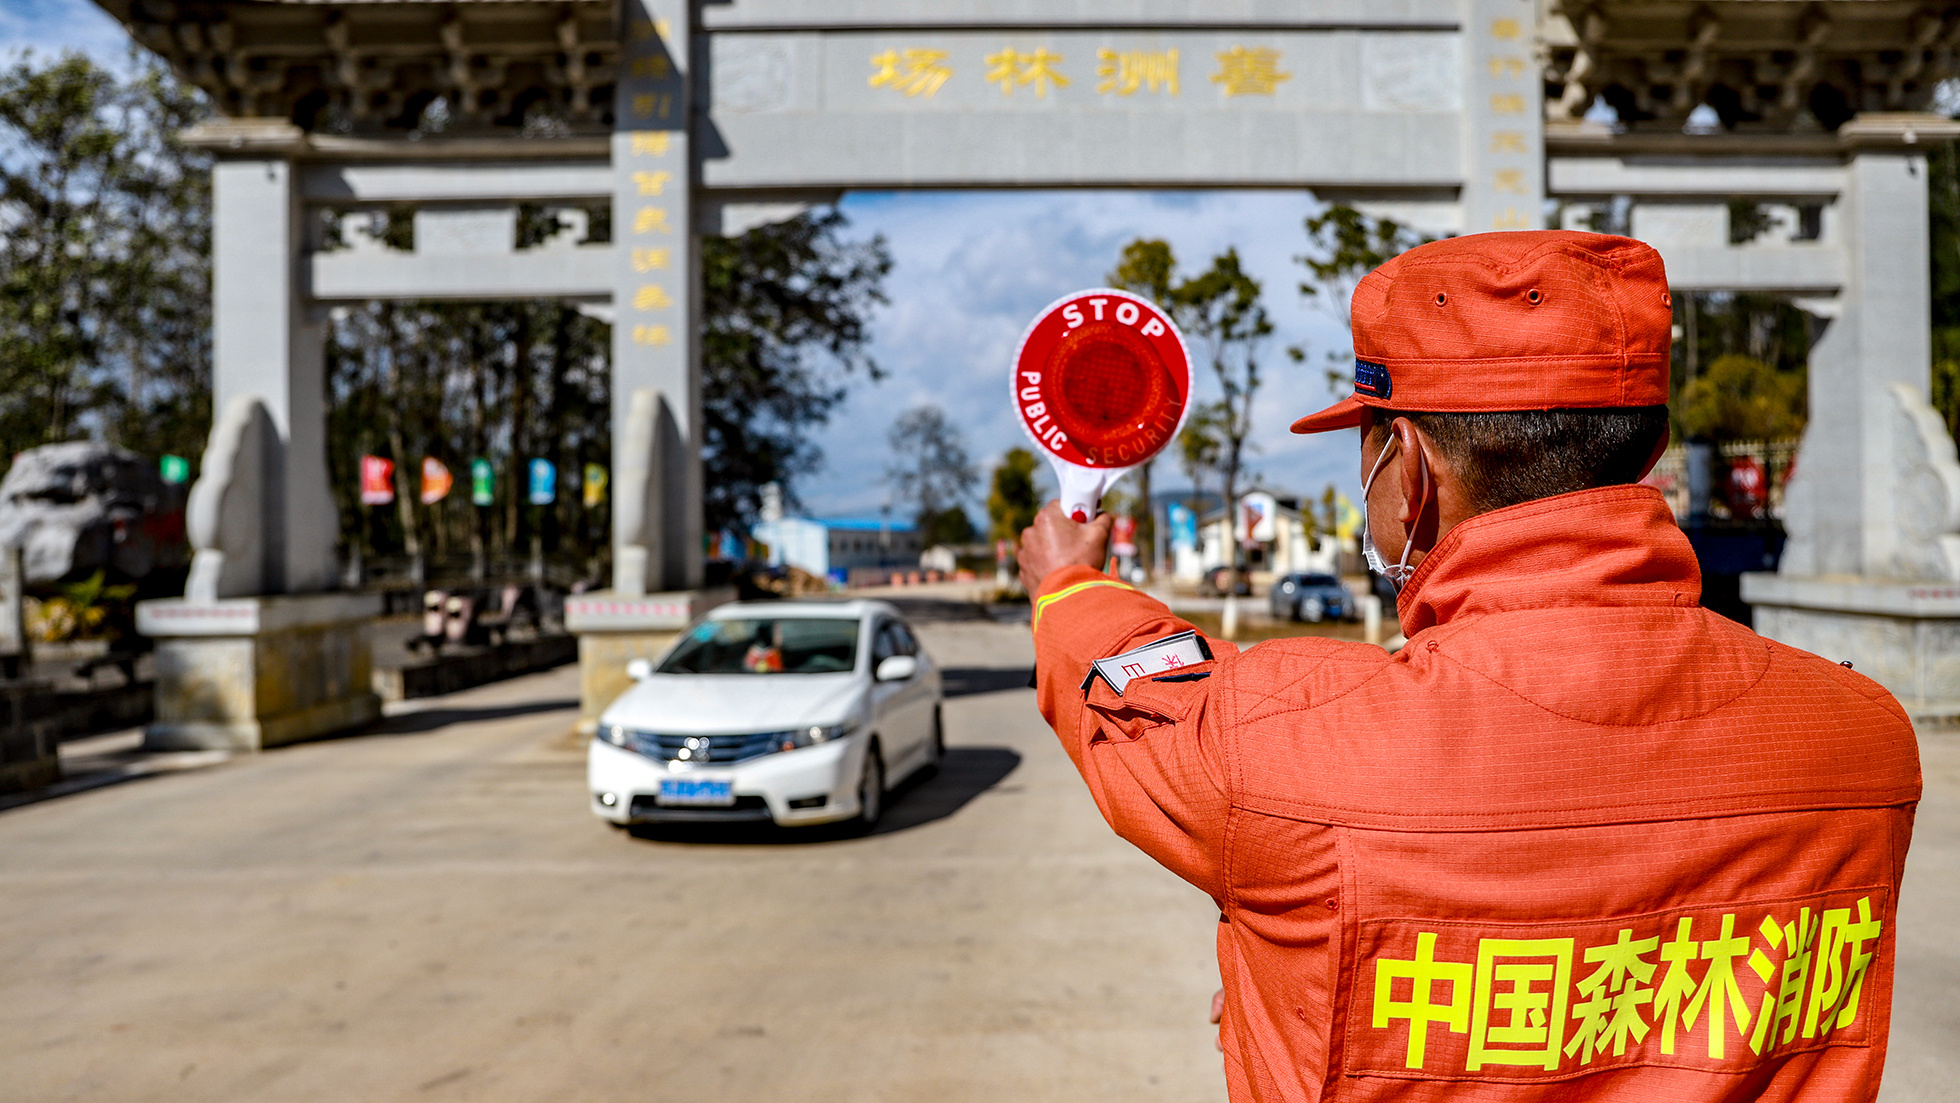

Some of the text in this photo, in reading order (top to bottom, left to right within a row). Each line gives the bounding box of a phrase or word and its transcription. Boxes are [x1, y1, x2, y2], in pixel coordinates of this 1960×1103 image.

[1062, 298, 1165, 337] STOP
[1021, 371, 1182, 465] PUBLIC SECURITY
[1371, 896, 1882, 1071] 中国森林消防
